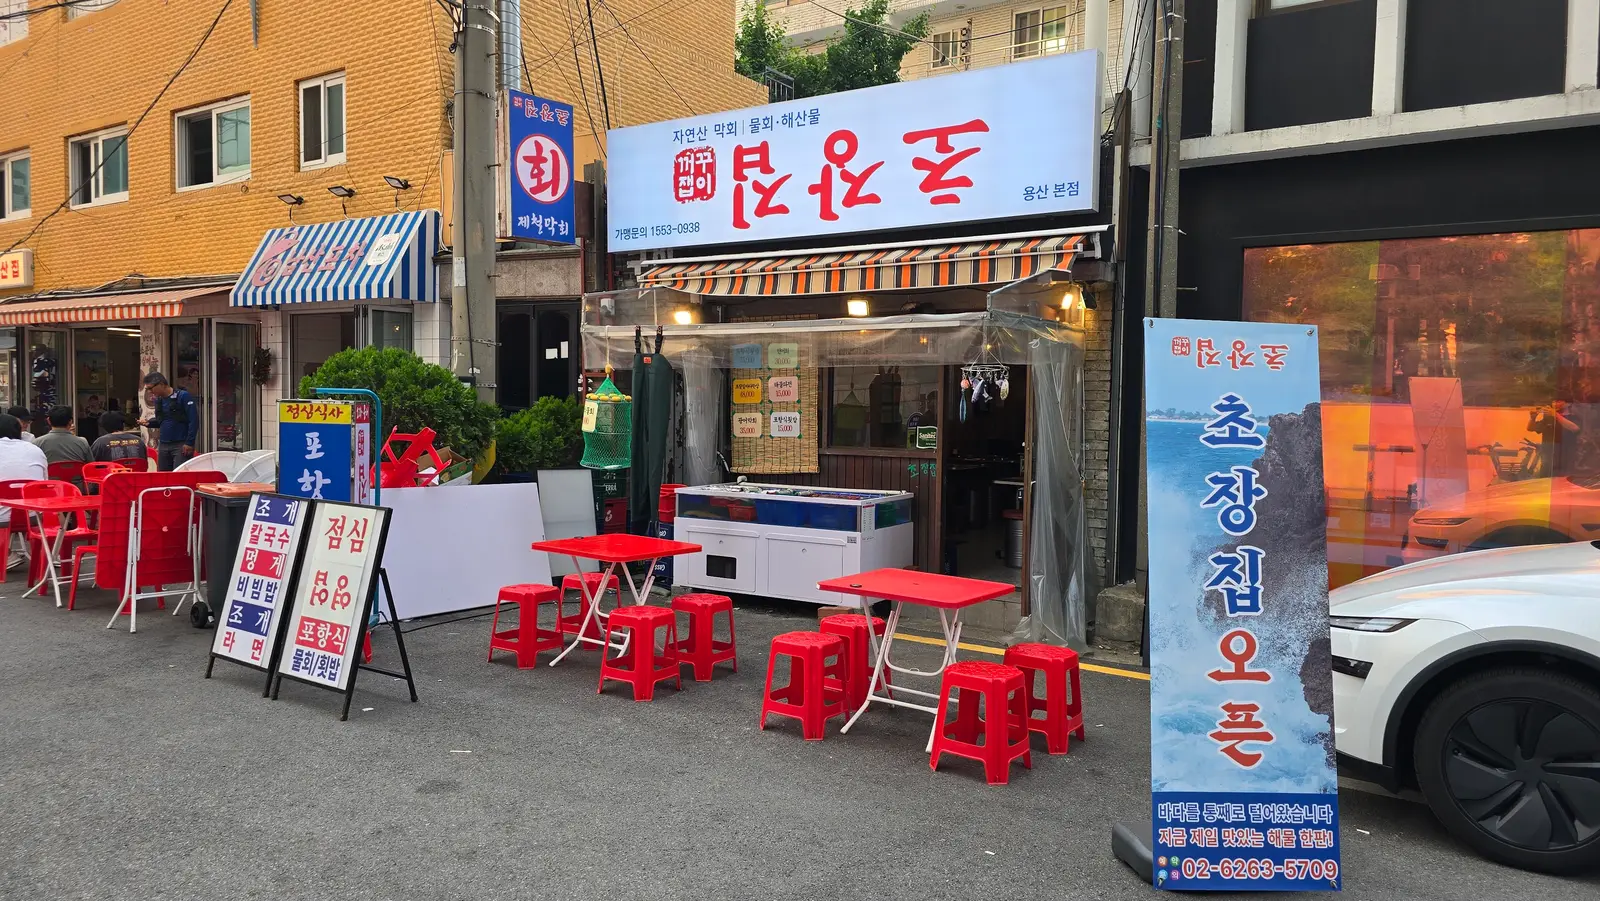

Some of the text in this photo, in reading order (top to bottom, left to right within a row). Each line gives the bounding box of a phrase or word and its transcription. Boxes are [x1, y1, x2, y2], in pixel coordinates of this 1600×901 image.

[524, 98, 569, 127] 초장집
[673, 125, 708, 145] 자연산
[714, 121, 737, 139] 막회
[522, 139, 560, 197] 회
[677, 152, 713, 174] 꺼꾸
[732, 118, 990, 229] 초장집
[1023, 180, 1079, 202] 용산 본점
[517, 212, 569, 236] 제철막회
[615, 222, 700, 241] 가맹문의 1553-0938
[1196, 337, 1290, 371] 초장집
[286, 403, 344, 421] 점심식사
[777, 424, 793, 432] 15,000
[249, 523, 290, 550] 칼국수
[324, 514, 369, 553] 점심
[236, 576, 278, 603] 비빔밥
[309, 569, 352, 611] 영업
[1199, 391, 1275, 770] 초장집 오픈
[222, 631, 265, 661] 라면
[298, 620, 348, 654] 포항식
[291, 648, 341, 682] 물회/횟밥
[1158, 802, 1334, 824] 바다를 통째로 털어왔습니다
[1158, 827, 1334, 849] 지금 제일 맛있는 해물 한판!
[1182, 857, 1339, 880] 02-6263-5709
